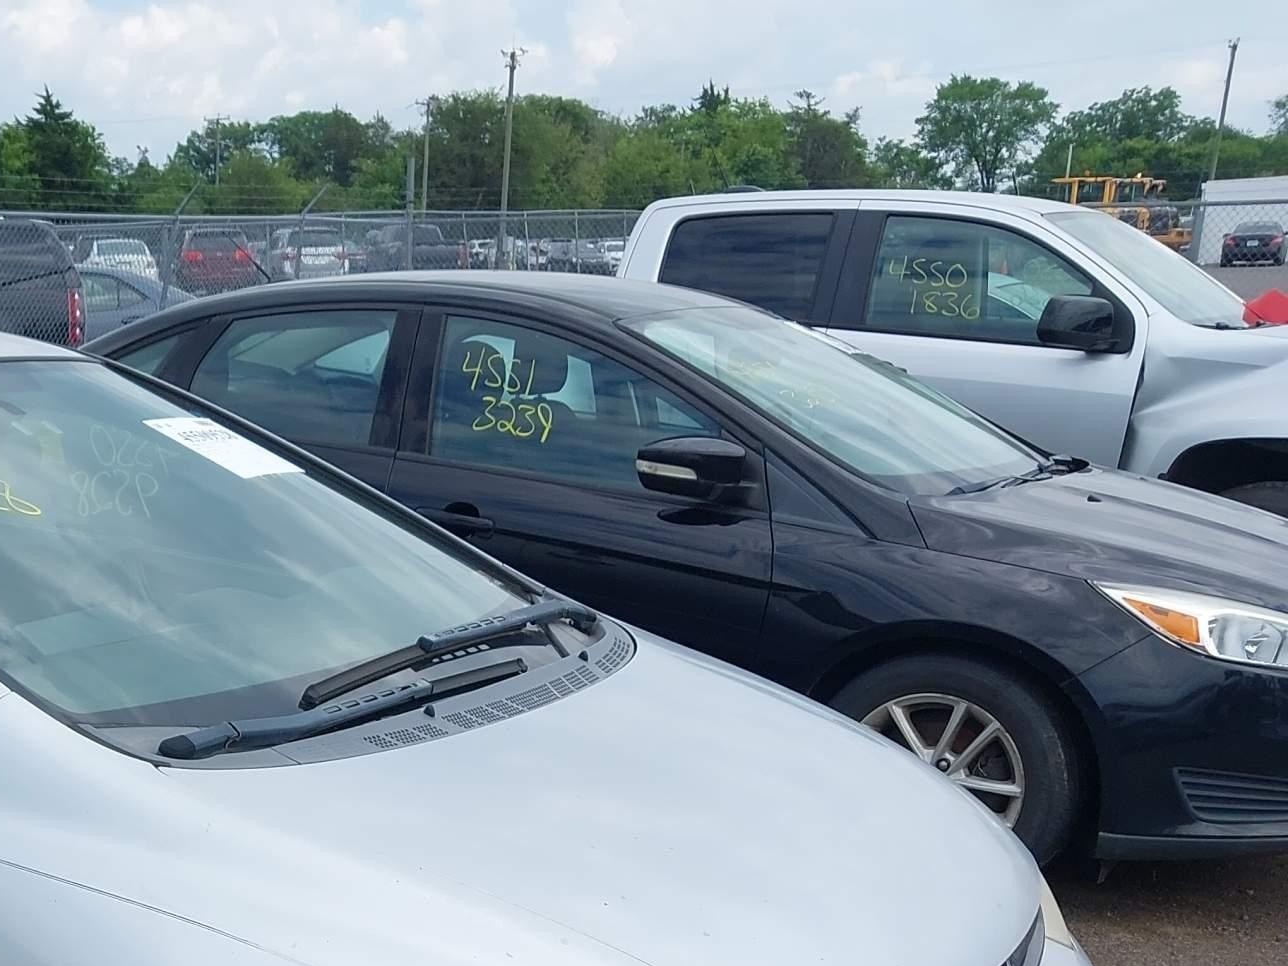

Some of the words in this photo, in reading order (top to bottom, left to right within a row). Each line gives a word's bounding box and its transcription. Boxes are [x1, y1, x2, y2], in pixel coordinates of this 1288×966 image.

[889, 255, 968, 288] 4550
[910, 288, 980, 320] 1836
[462, 346, 536, 399] 4551
[472, 396, 553, 443] 3239
